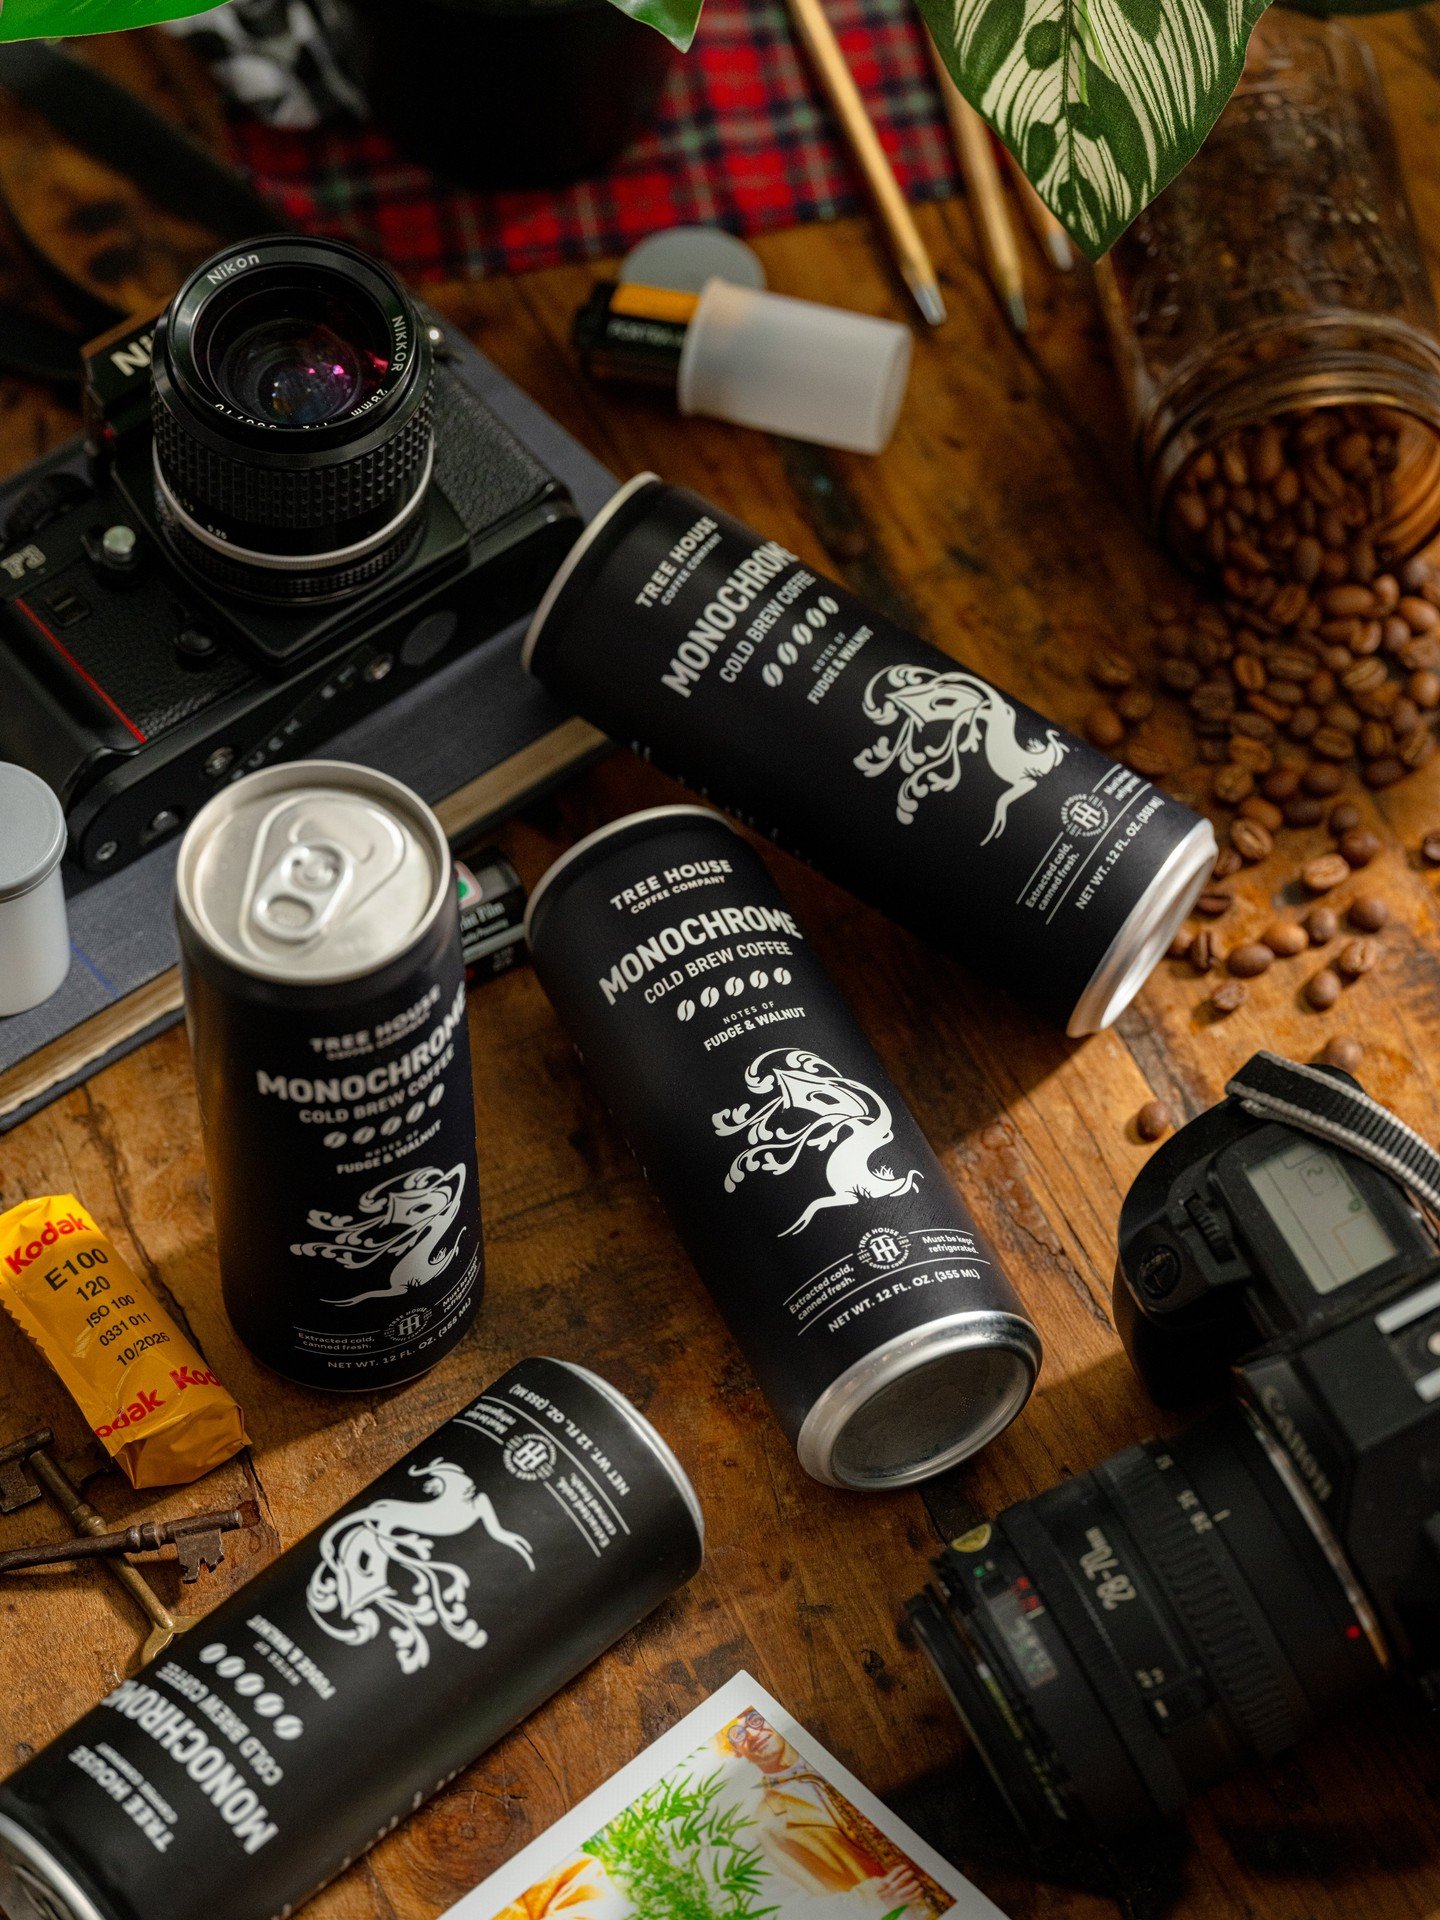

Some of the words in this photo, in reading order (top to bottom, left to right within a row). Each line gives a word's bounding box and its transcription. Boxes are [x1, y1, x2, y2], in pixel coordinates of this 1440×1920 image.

[206, 252, 261, 285] Nikon
[391, 315, 409, 373] NIKKOR
[0, 544, 46, 580] F3
[635, 560, 677, 608] TREE
[669, 516, 718, 563] HOUSE
[661, 568, 691, 606] COFFEE
[660, 541, 800, 698] MONOCHROM
[719, 639, 755, 683] COLD
[745, 598, 785, 643] BREW
[776, 570, 817, 605] COFFEE
[807, 665, 840, 705] FUDGE
[610, 875, 662, 911] TREE
[663, 859, 734, 884] HOUSE
[1025, 863, 1058, 908] Extracted
[1054, 842, 1073, 865] cold,
[1038, 878, 1063, 911] canned
[1058, 852, 1080, 878] fresh.
[1075, 884, 1096, 910] NET
[1090, 866, 1111, 887] WT.
[1105, 850, 1120, 865] 12
[1114, 837, 1131, 852] FL.
[1125, 821, 1143, 837] OZ.
[630, 888, 671, 914] COFFEE
[671, 875, 726, 894] COMPANY
[599, 905, 804, 1006] MONOCHROME
[644, 970, 684, 1004] COLD
[685, 948, 735, 978] BREW
[736, 941, 793, 959] COFFEE
[704, 1023, 745, 1051] FUDGE
[745, 1019, 756, 1031] &
[755, 1007, 806, 1027] WALNUT
[722, 1006, 758, 1024] NOTES
[762, 1001, 775, 1010] OF
[256, 981, 466, 1104] MONOCHROM
[299, 1108, 349, 1124] COLD
[353, 1088, 406, 1120] BREW
[407, 1043, 455, 1098] COFFEE
[336, 1157, 381, 1174] FUDGE
[395, 1119, 441, 1158] WALNUT
[4, 1213, 91, 1275] Kodak
[859, 1232, 872, 1248] TREE
[871, 1227, 899, 1236] HOUSE
[922, 1235, 946, 1244] Must
[945, 1235, 957, 1243] be
[44, 1248, 109, 1292] E100
[76, 1275, 111, 1302] 120
[789, 1279, 830, 1315] Extracted
[830, 1264, 854, 1282] cold,
[85, 1303, 110, 1329] ISO
[111, 1294, 135, 1312] 100
[798, 1293, 828, 1321] canned
[827, 1277, 856, 1296] fresh.
[828, 1313, 852, 1333] NET
[852, 1299, 875, 1315] WT.
[876, 1288, 890, 1303] 12
[893, 1282, 911, 1296] FL.
[912, 1274, 935, 1286] OZ.
[935, 1269, 960, 1282] (355
[960, 1268, 980, 1279] ML)
[99, 1320, 129, 1347] 0331
[129, 1312, 152, 1327] 011
[116, 1331, 171, 1368] 10/2026
[298, 1331, 349, 1345] Extracted
[350, 1335, 376, 1344] cold,
[303, 1340, 341, 1351] canned
[341, 1342, 372, 1351] fresh.
[328, 1361, 352, 1369] NET
[355, 1359, 379, 1368] WT.
[383, 1354, 397, 1364] 12
[400, 1348, 415, 1360] FL.
[418, 1335, 437, 1350] OZ.
[439, 1315, 458, 1338] (355
[95, 1388, 167, 1439] odak
[169, 1365, 223, 1391] Kod
[546, 1404, 565, 1424] OZ.
[576, 1433, 594, 1451] 12
[590, 1447, 612, 1473] WT.
[606, 1469, 631, 1497] NET
[100, 1678, 279, 1855] MONOCHROM
[239, 1735, 284, 1787] COLD
